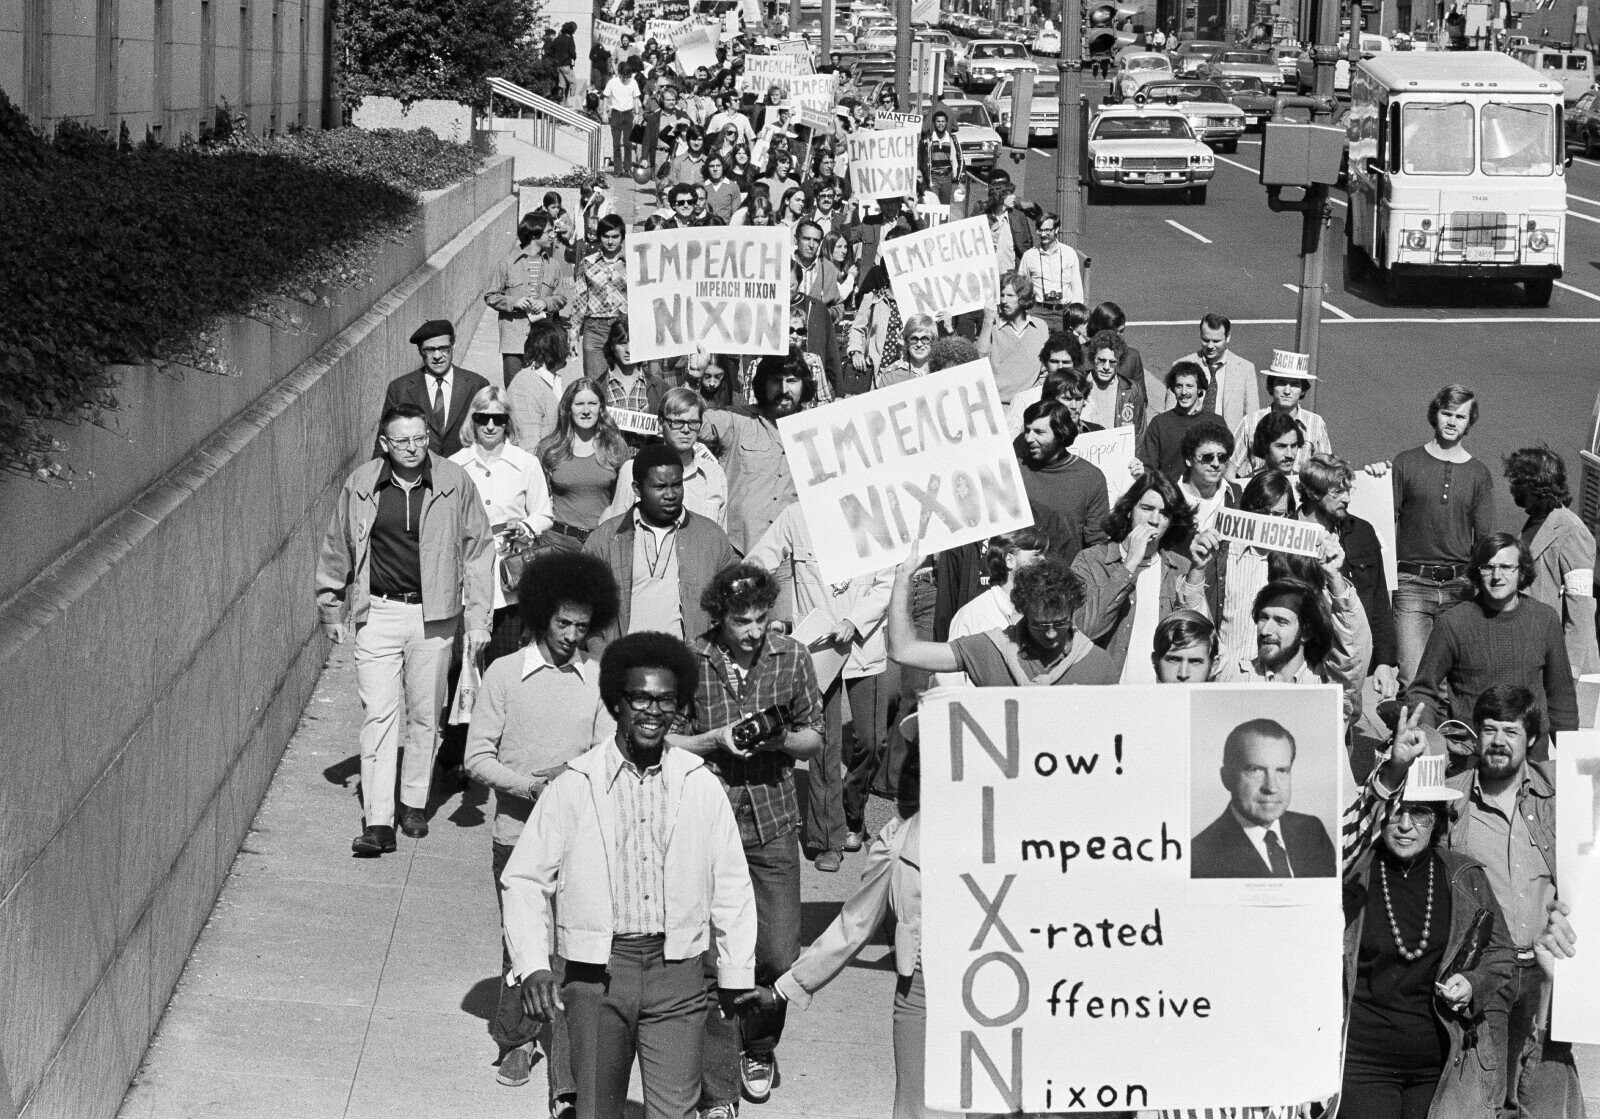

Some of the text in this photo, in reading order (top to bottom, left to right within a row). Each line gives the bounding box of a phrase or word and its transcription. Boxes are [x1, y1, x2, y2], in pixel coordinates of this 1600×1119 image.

[648, 22, 672, 30] IMPEA
[747, 57, 792, 73] IMPEACH
[877, 111, 922, 123] WANTED
[850, 135, 914, 162] IMPEACH
[857, 166, 915, 194] NIXON
[633, 239, 782, 286] IMPEACH
[887, 223, 989, 277] IMPEACH
[696, 281, 777, 300] IMPEACH NIXON
[909, 266, 997, 314] NIXON
[653, 293, 782, 351] NIXON
[630, 414, 657, 432] NIXON
[791, 379, 999, 487] IMPEACH
[838, 458, 1022, 559] NIXON
[1214, 511, 1257, 541] NIXON
